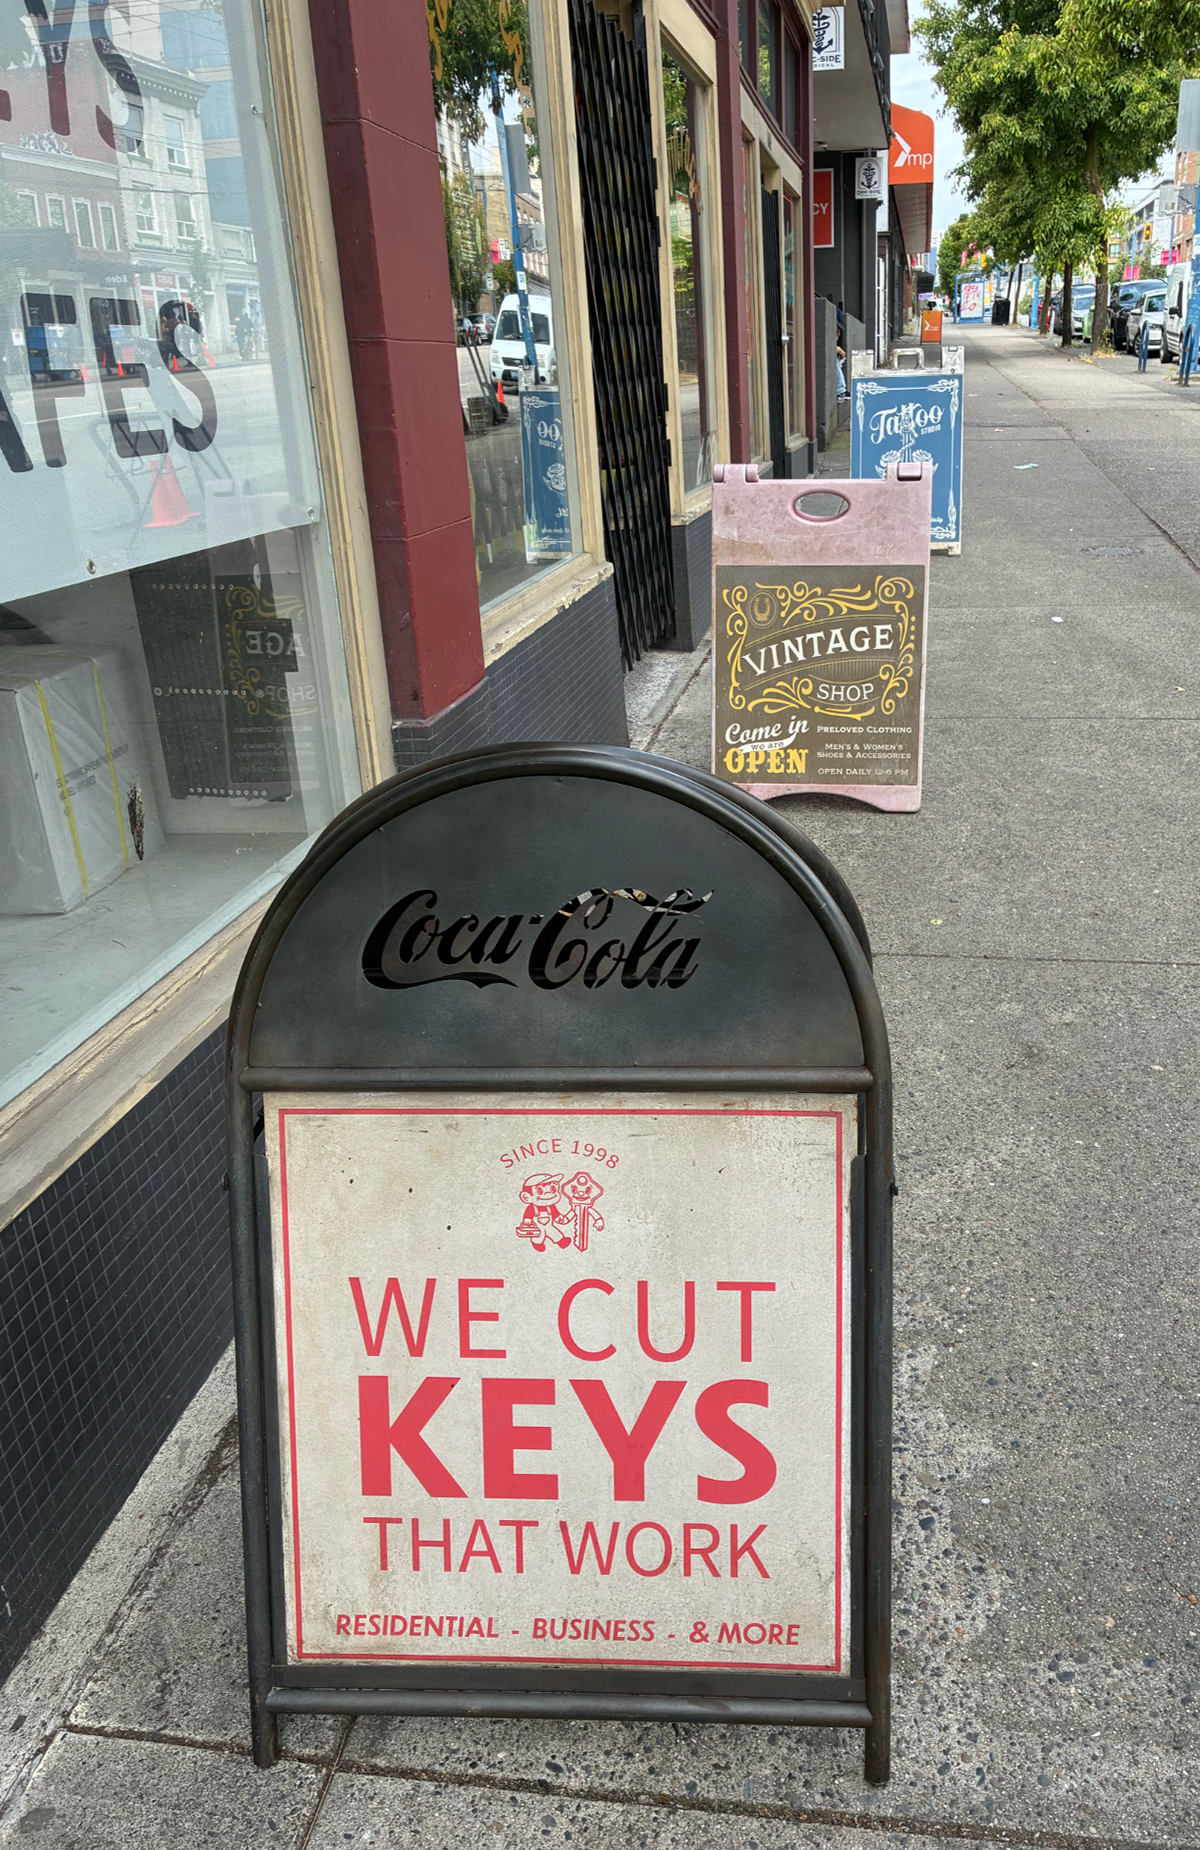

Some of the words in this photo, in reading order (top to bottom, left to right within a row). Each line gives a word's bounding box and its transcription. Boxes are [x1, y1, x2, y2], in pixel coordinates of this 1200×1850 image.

[0, 0, 144, 153] YS
[920, 424, 941, 435] STUDIO
[741, 624, 895, 677] VINTAGE
[817, 683, 875, 701] SHOP
[725, 723, 783, 744] Come
[788, 716, 809, 735] in
[817, 726, 864, 734] PRELOVED
[866, 726, 912, 734] CLOTHING
[750, 743, 765, 751] we
[767, 741, 784, 749] are
[816, 751, 844, 759] SHOES
[863, 743, 904, 751] WOMEN'S
[724, 747, 809, 774] OPEN
[845, 768, 872, 776] DAILY
[500, 1139, 562, 1169] SINCE
[571, 1140, 620, 1169] 1998
[349, 1277, 507, 1359] WE
[557, 1279, 777, 1363] CUT
[358, 1375, 778, 1505] KEYS
[363, 1517, 540, 1575] THAT
[558, 1520, 771, 1579] WORK
[336, 1614, 499, 1639] RESIDENTIAL
[532, 1618, 656, 1643] BUSINESS
[689, 1621, 710, 1643] &
[717, 1621, 801, 1646] MORE
